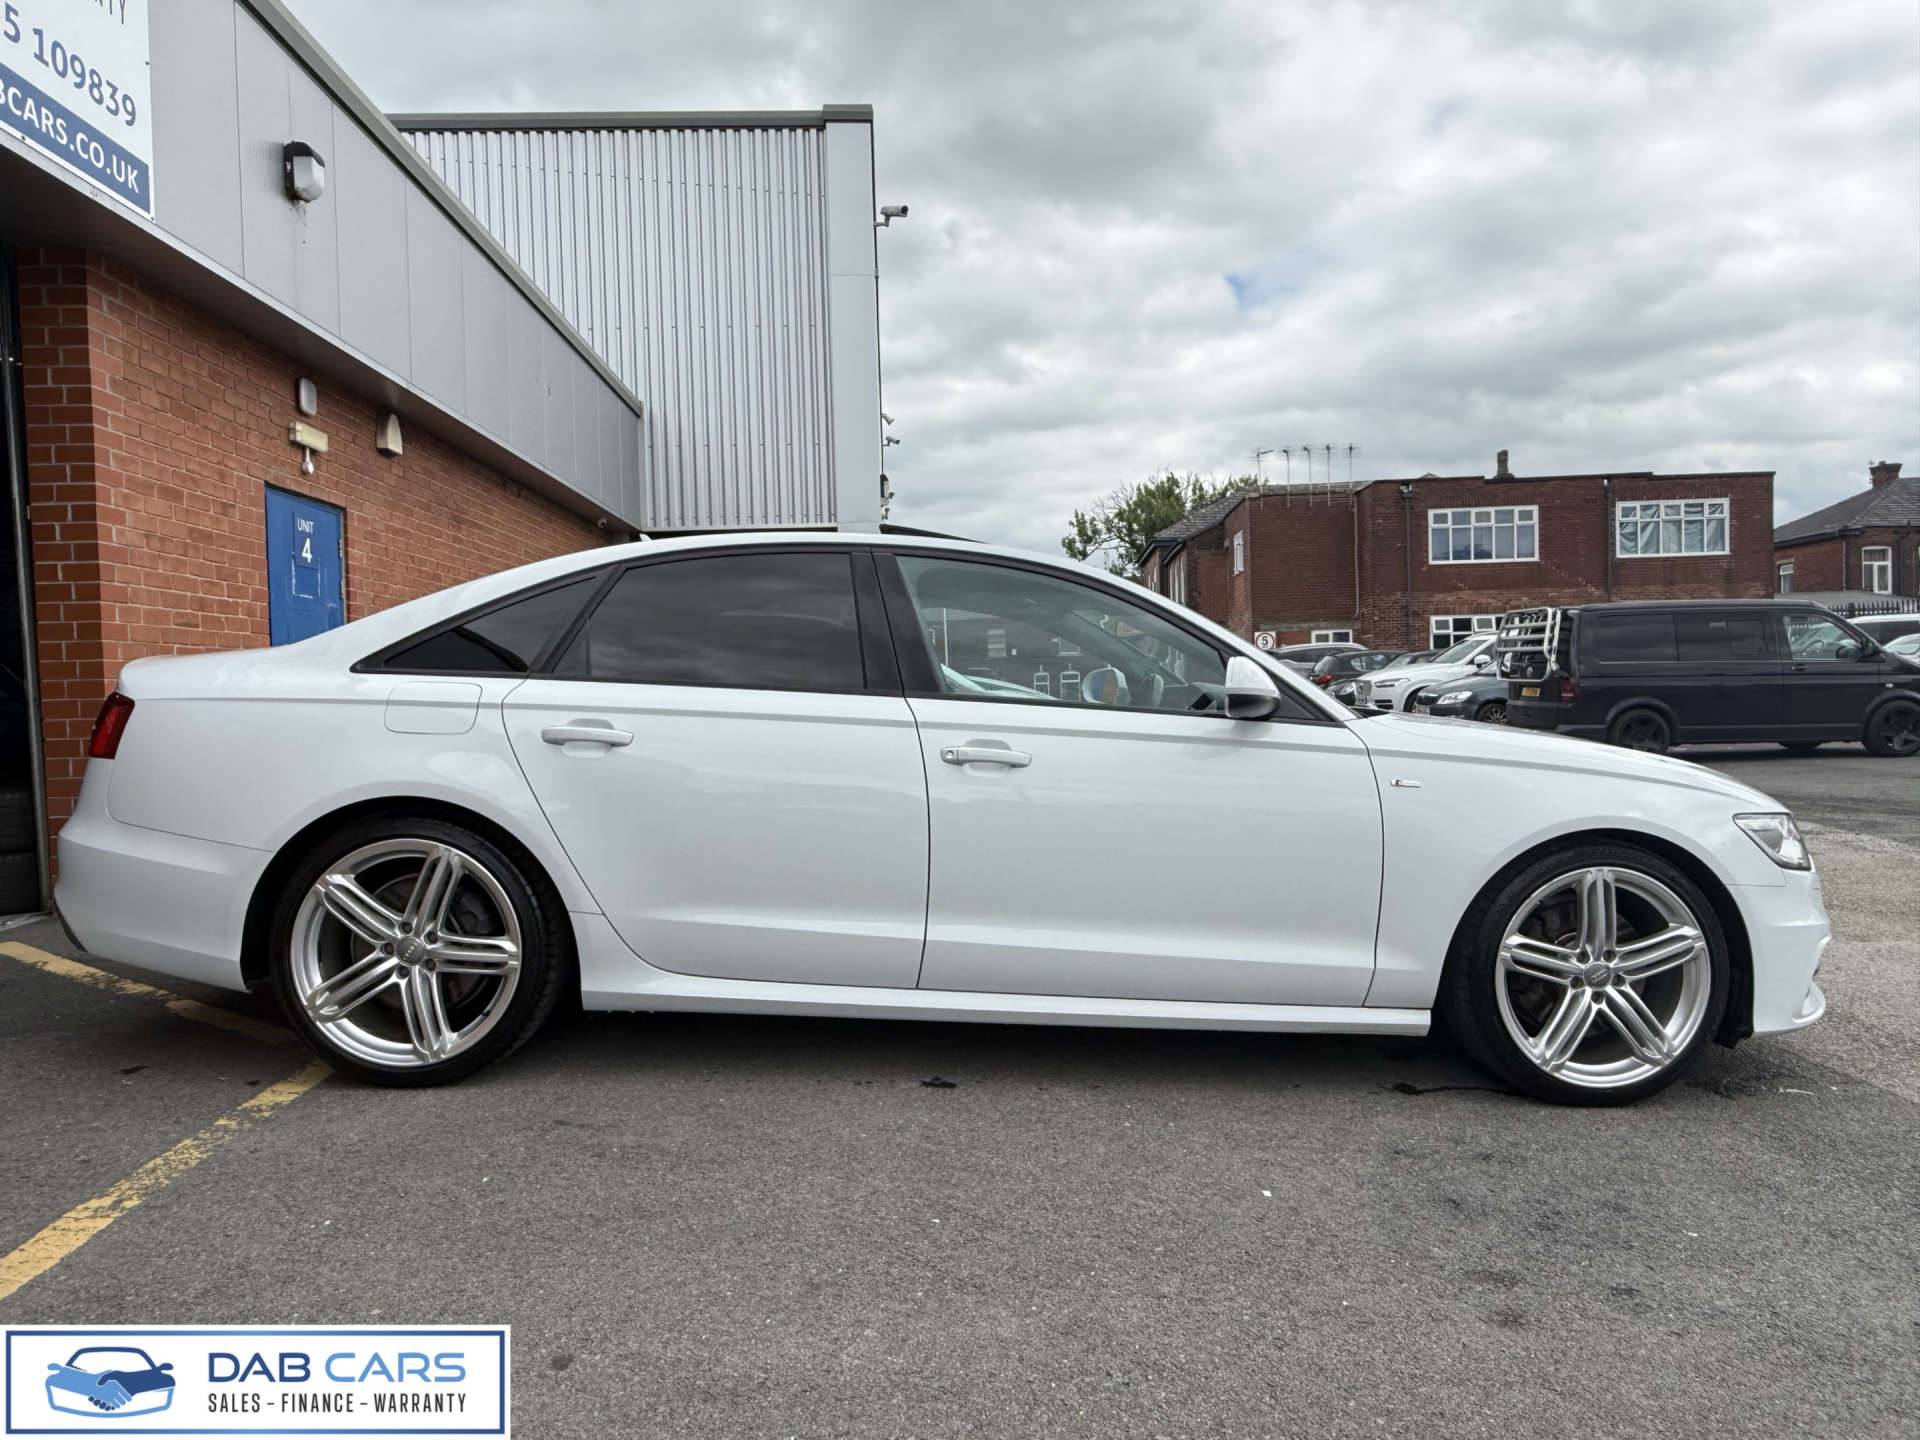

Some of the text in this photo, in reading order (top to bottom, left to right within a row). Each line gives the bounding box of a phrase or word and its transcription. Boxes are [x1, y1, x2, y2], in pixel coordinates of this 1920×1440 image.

[32, 28, 137, 127] 109839
[297, 517, 314, 534] UNIT
[301, 538, 312, 563] 4
